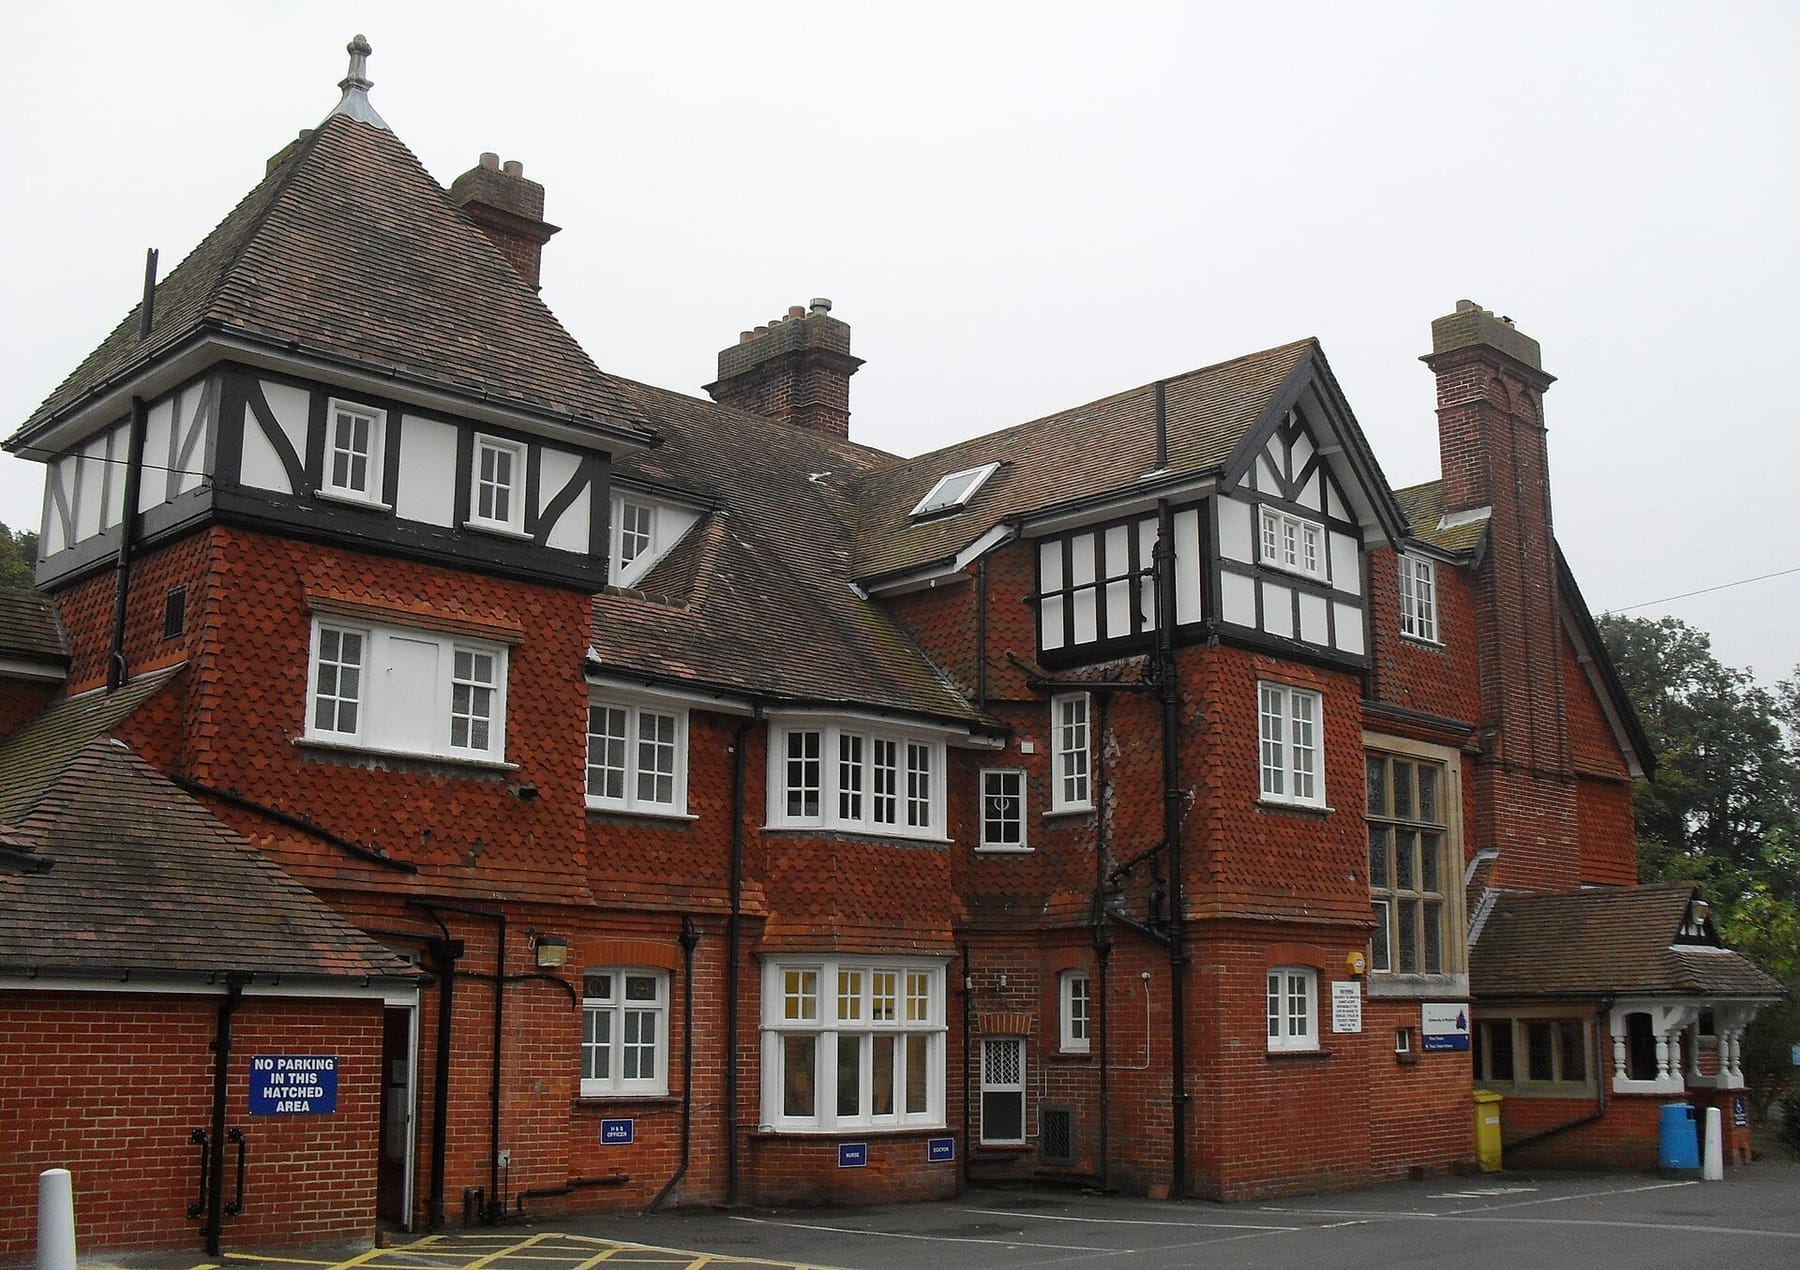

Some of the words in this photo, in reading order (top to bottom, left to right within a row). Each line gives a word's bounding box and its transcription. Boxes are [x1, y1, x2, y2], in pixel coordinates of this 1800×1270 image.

[254, 1059, 274, 1070] NO
[277, 1059, 334, 1070] PARKING
[270, 1073, 284, 1084] IN
[288, 1073, 318, 1084] THIS
[263, 1087, 324, 1098] HATCHED
[276, 1101, 310, 1112] AREA
